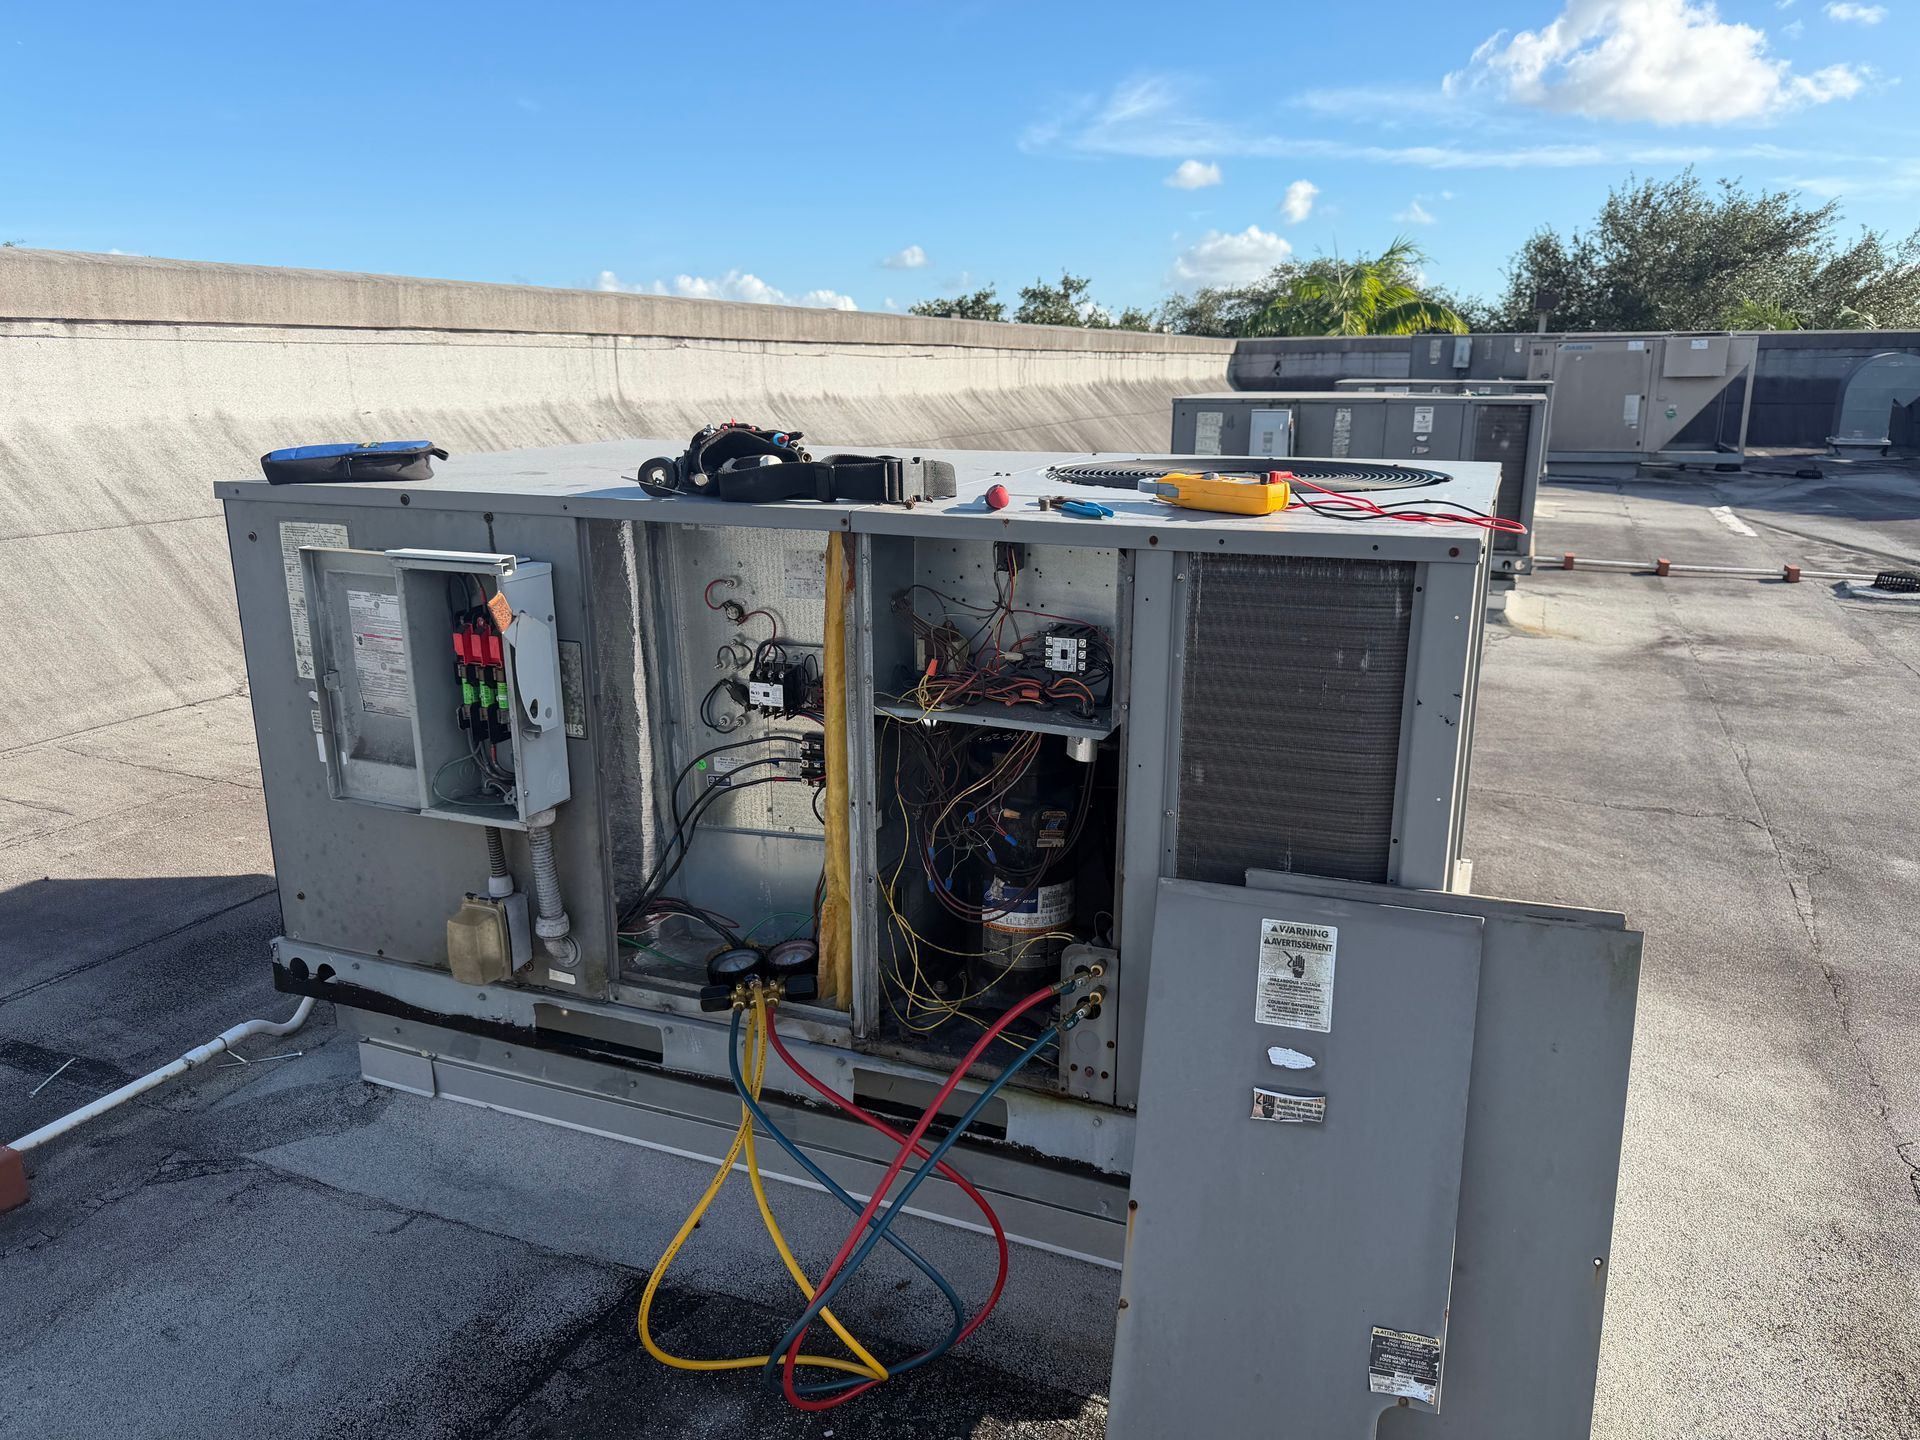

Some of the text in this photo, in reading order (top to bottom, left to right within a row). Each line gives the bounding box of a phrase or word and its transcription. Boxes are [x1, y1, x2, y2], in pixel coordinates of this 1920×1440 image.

[566, 723, 584, 736] RIES
[1279, 925, 1329, 939] WARNING
[1270, 937, 1333, 952] AVERTISSEMENT
[1270, 977, 1300, 985] HAZARDOUS
[1380, 1330, 1439, 1345] ATTENTION/CAUTION
